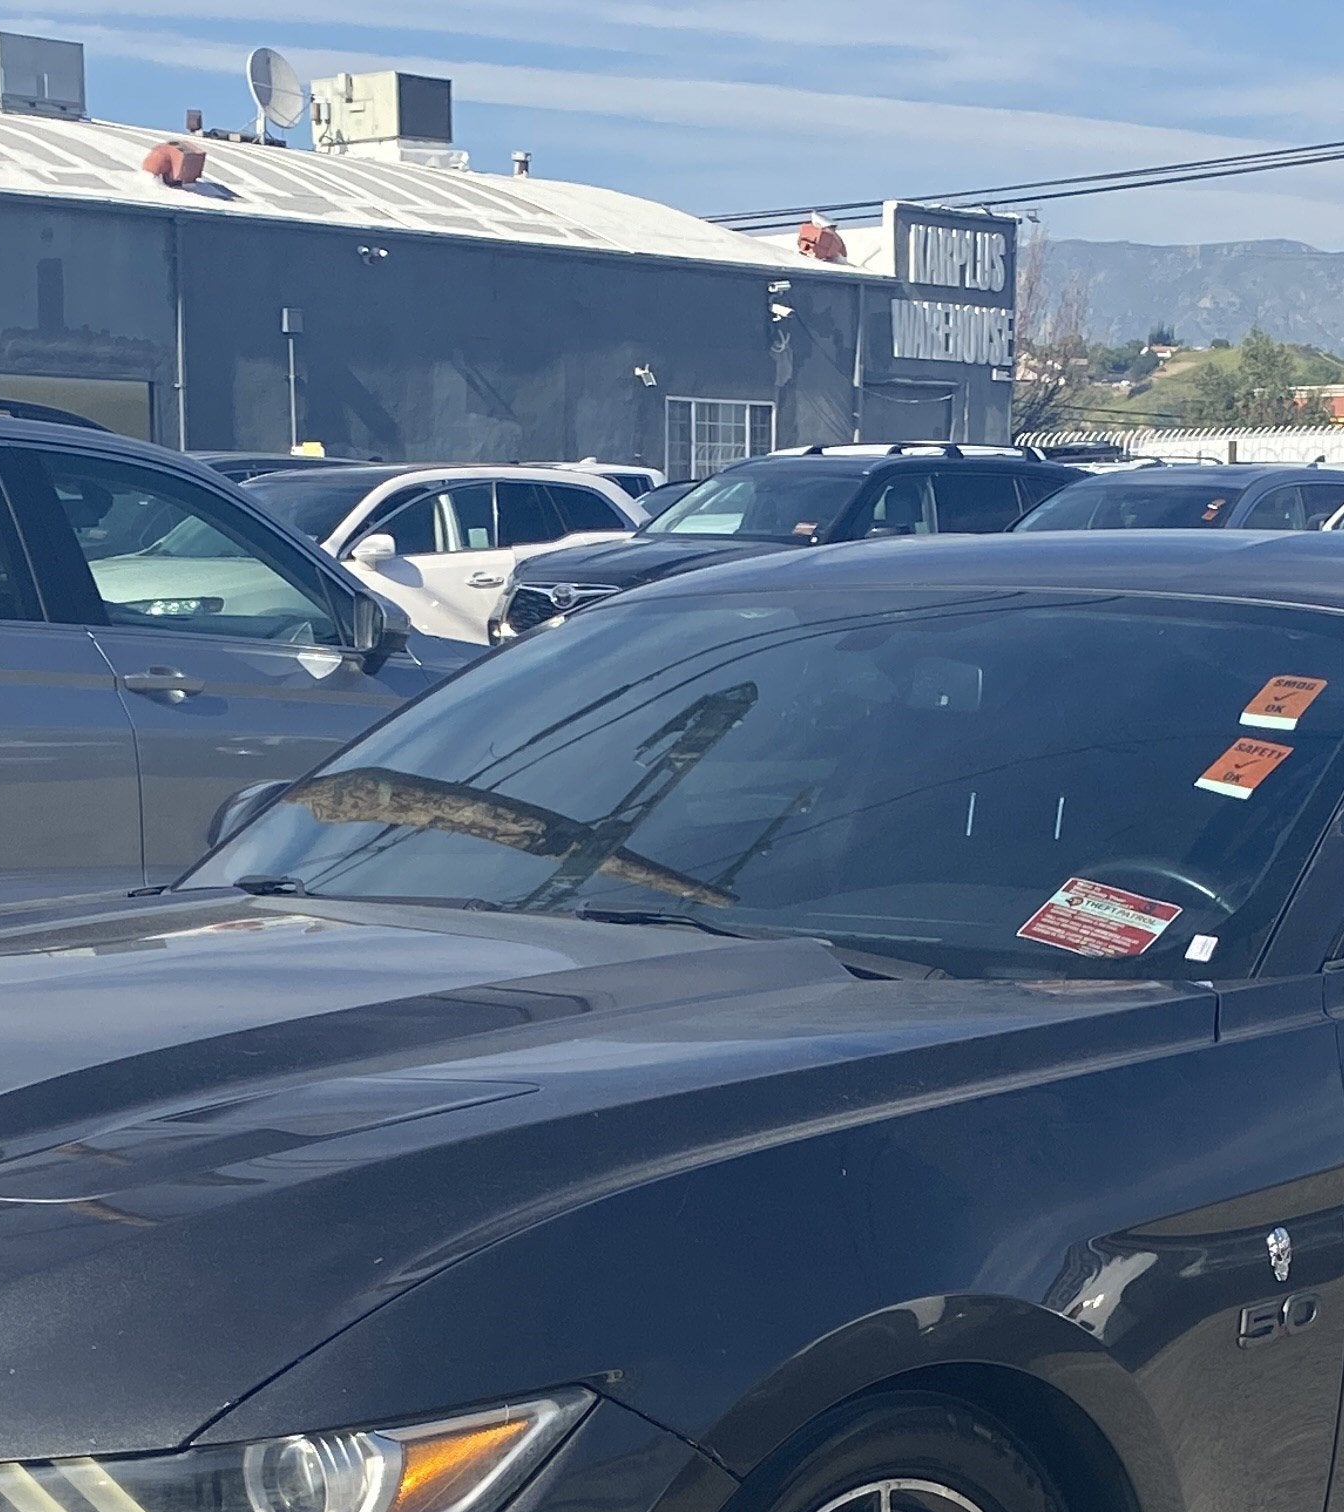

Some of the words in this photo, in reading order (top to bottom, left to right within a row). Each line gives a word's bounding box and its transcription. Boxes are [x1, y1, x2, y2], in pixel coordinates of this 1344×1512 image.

[908, 223, 1006, 293] KARPLUS
[890, 298, 1014, 367] WAREHOUSE
[1272, 678, 1317, 691] SMOG
[1264, 704, 1286, 714] OK
[1233, 742, 1287, 760] SAFETY
[1222, 771, 1243, 783] OK
